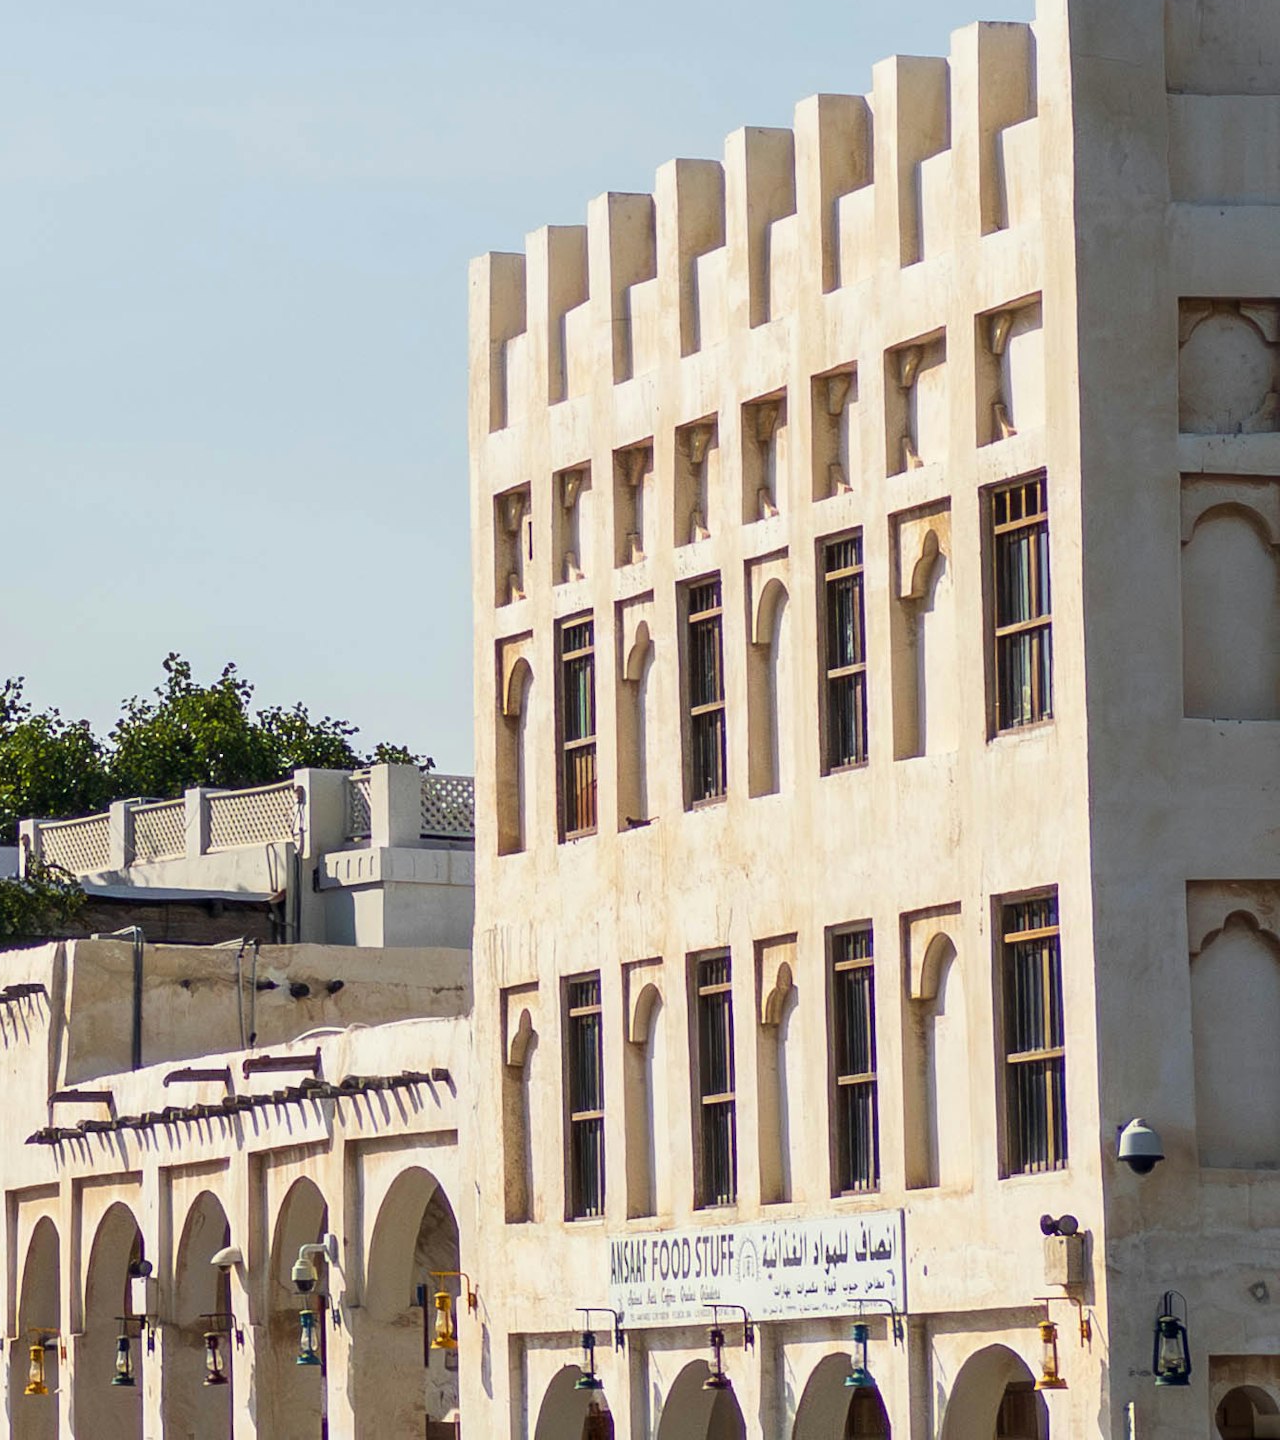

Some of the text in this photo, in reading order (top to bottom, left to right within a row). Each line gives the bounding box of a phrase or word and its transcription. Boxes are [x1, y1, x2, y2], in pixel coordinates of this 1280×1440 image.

[611, 1234, 734, 1285] ANSAAF FOOD STUFF
[762, 1229, 807, 1280] الغذائية
[813, 1229, 848, 1276] للمواد
